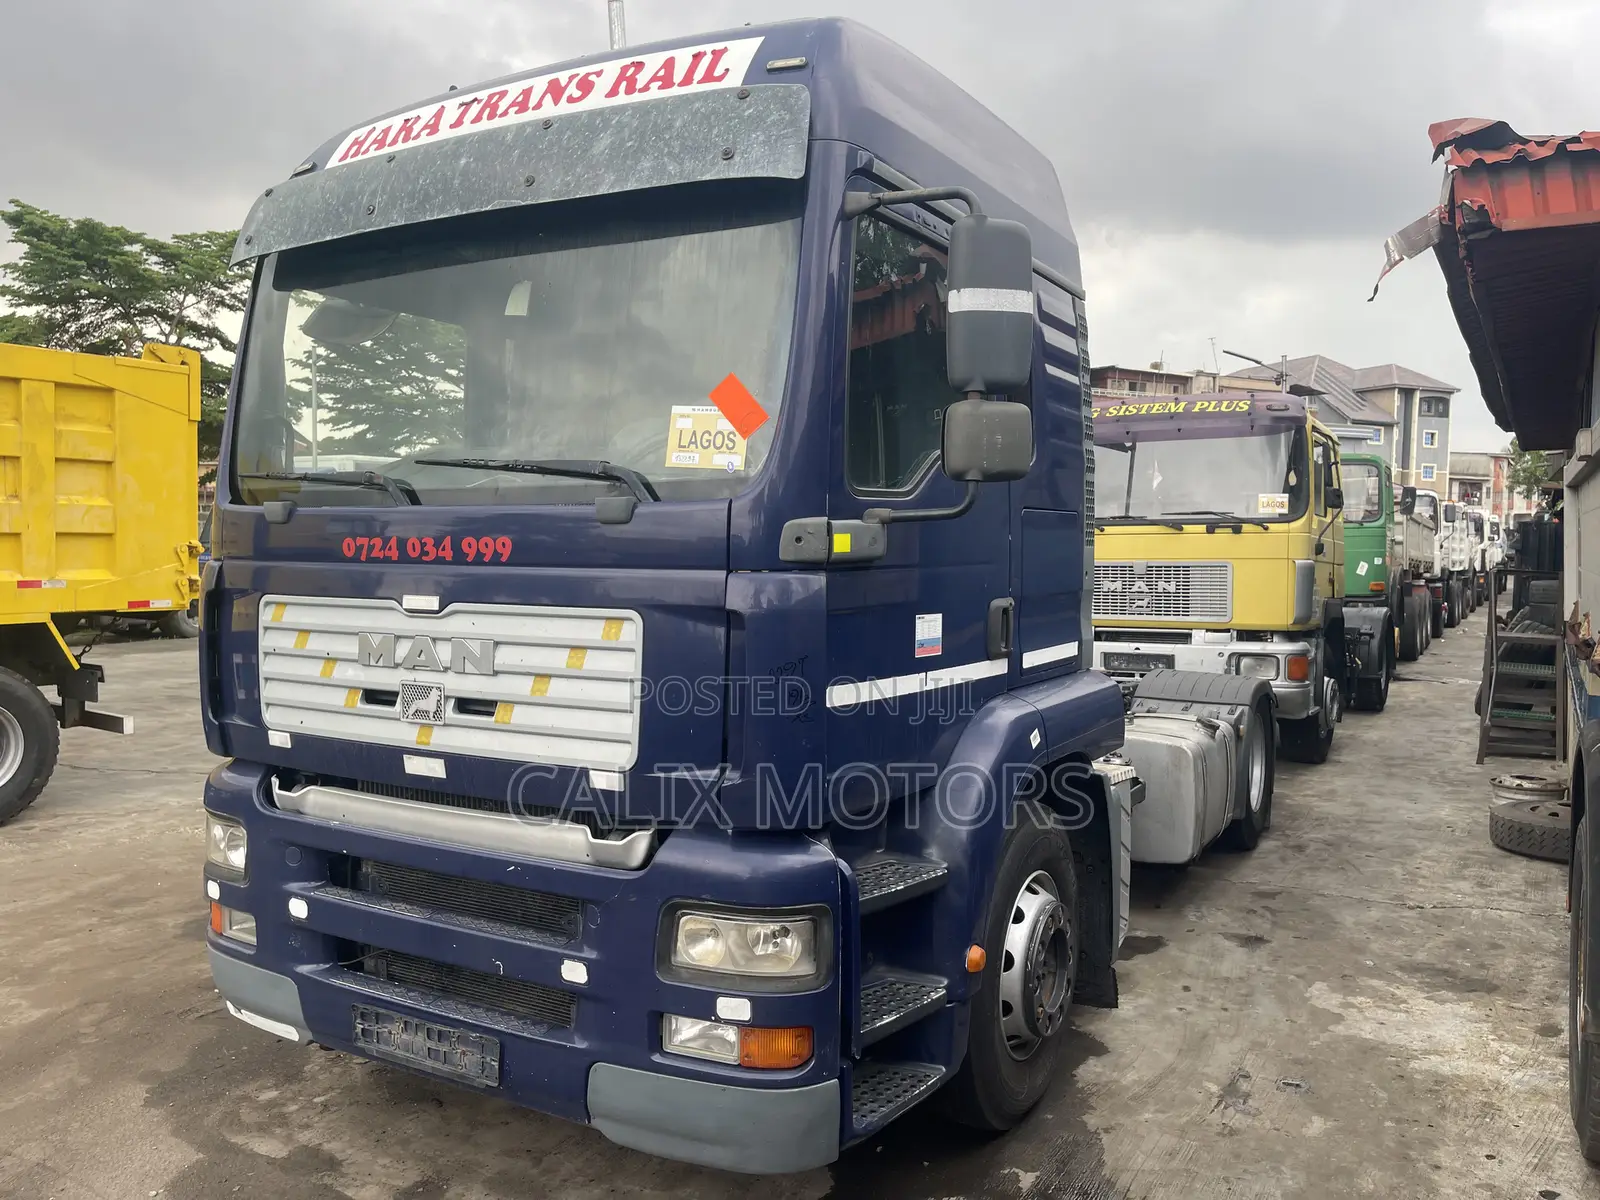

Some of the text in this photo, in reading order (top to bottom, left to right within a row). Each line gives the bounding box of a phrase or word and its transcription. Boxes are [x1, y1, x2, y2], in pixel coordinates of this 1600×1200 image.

[449, 69, 604, 130] TRANS
[604, 46, 730, 99] RAIL
[1106, 401, 1188, 417] SISTEM
[1192, 400, 1252, 413] PLUS
[678, 429, 737, 451] LAGOS
[1261, 500, 1285, 509] LAGOS
[342, 535, 513, 563] 0724 034 999
[1102, 580, 1177, 593] MAN
[358, 632, 495, 675] MAN
